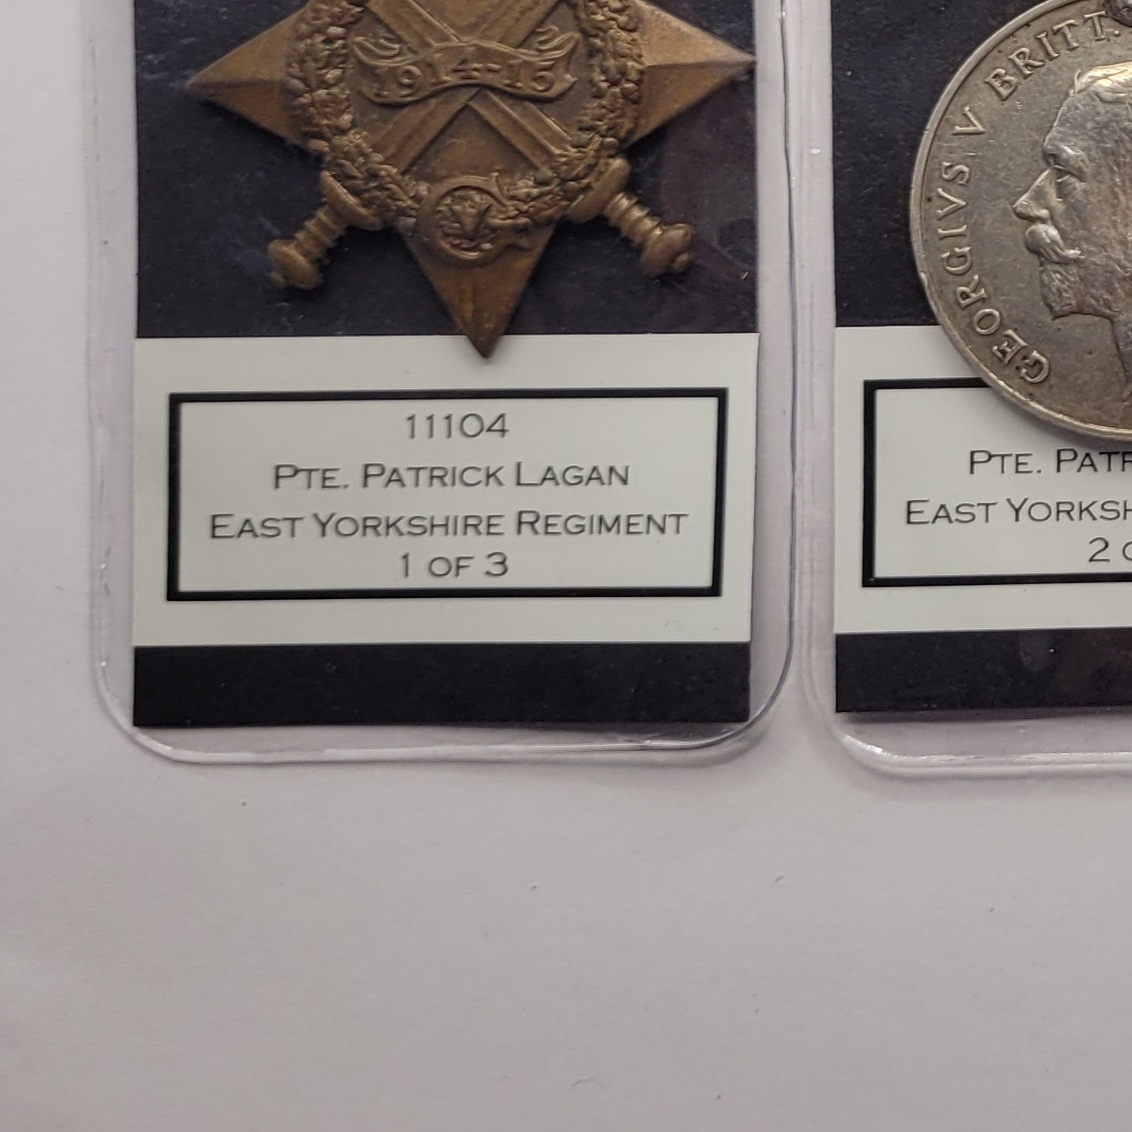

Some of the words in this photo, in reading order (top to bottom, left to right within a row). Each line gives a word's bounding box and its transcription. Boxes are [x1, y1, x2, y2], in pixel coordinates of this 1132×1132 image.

[374, 48, 558, 98] 1914-15
[951, 105, 986, 138] V
[937, 159, 1050, 384] GEORGIVS
[405, 412, 511, 440] 11104
[273, 463, 350, 490] PTE.
[361, 462, 505, 489] PATRICK
[515, 461, 631, 487] LAGAN
[968, 449, 1043, 476] PTE.
[209, 513, 304, 540] EAST
[312, 511, 505, 539] YORKSHIRE
[515, 509, 690, 536] REGIMENT
[905, 499, 998, 525] EAST
[1087, 536, 1112, 564] 2
[399, 552, 411, 579] 1
[427, 555, 475, 578] OF
[484, 551, 510, 578] 3
